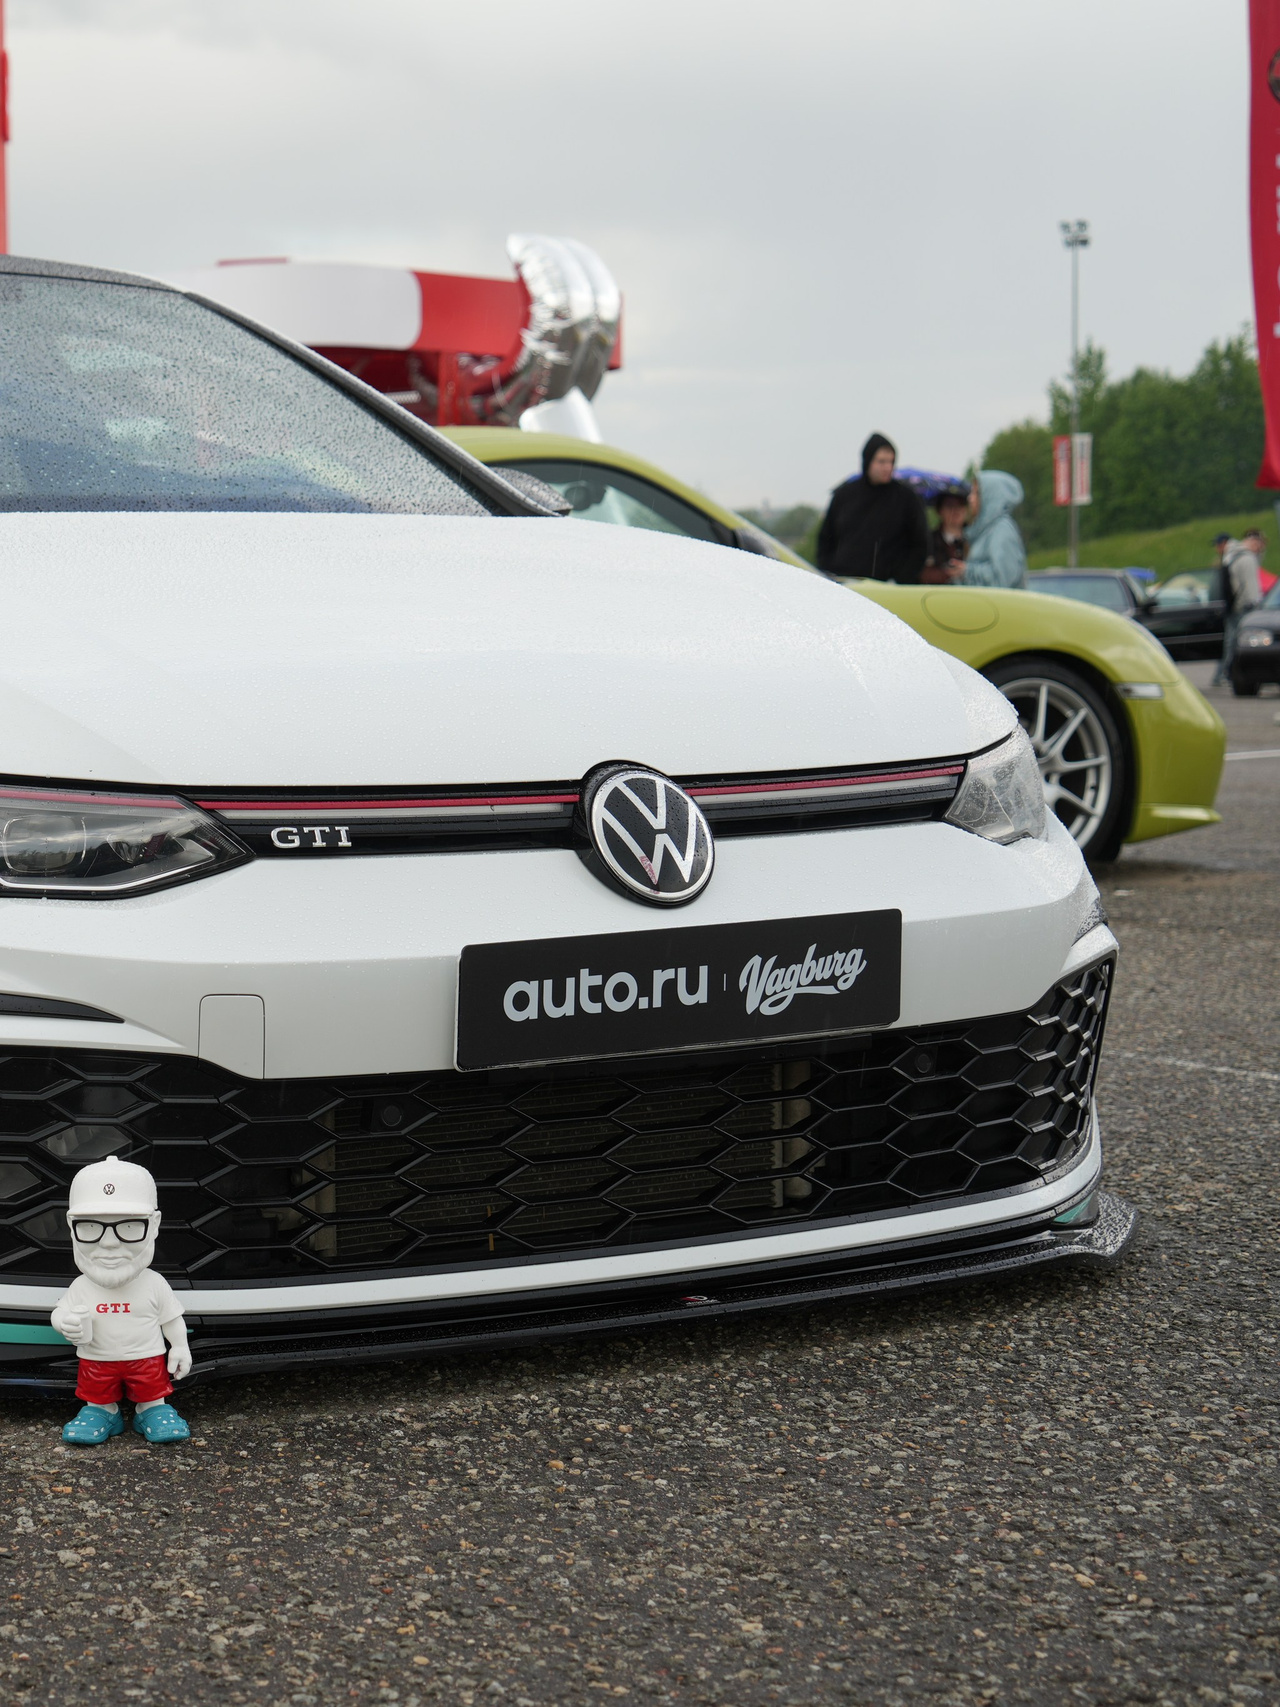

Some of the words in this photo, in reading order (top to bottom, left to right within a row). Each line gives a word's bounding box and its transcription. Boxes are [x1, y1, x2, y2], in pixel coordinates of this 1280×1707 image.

[270, 826, 352, 849] GTI
[503, 965, 708, 1022] auto.ru
[739, 943, 867, 1016] Vagburg
[95, 1303, 131, 1314] GTI
